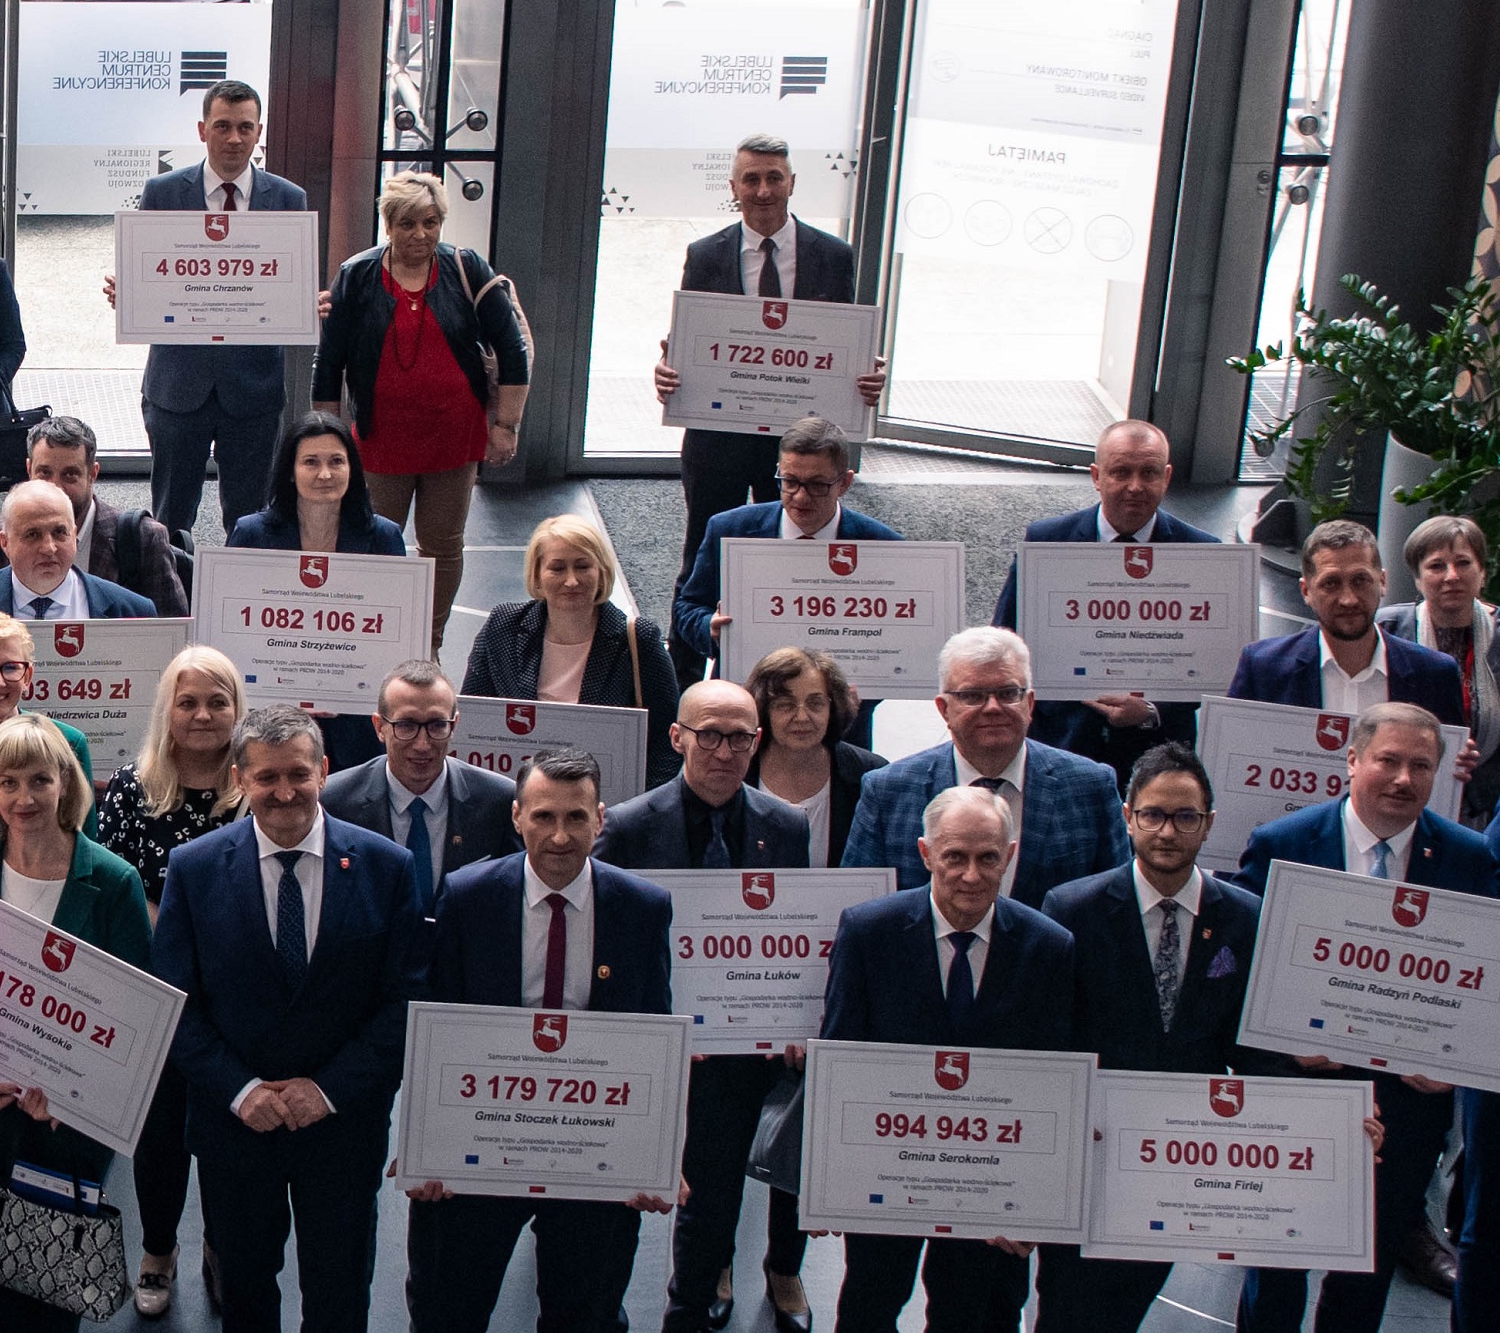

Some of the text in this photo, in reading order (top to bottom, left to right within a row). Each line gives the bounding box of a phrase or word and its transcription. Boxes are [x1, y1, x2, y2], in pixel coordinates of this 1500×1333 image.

[156, 258, 278, 276] 4 603 979 zł
[183, 283, 253, 292] Gmina Chrzanów
[770, 595, 916, 617] 3 196 230 zł
[240, 606, 383, 633] 1 082 106 zł
[806, 625, 883, 638] Gmina Frampol
[265, 637, 357, 652] Gmina Strzyżewice
[41, 995, 86, 1032] 000
[89, 1025, 115, 1048] zł
[30, 1022, 73, 1051] Wysokie
[460, 1073, 630, 1105] 3 179 720 zł
[473, 1109, 616, 1127] Gmina Stoczek Łukowski
[875, 1112, 1022, 1143] 994 943 zł
[897, 1149, 1000, 1165] Gmina Serokomla
